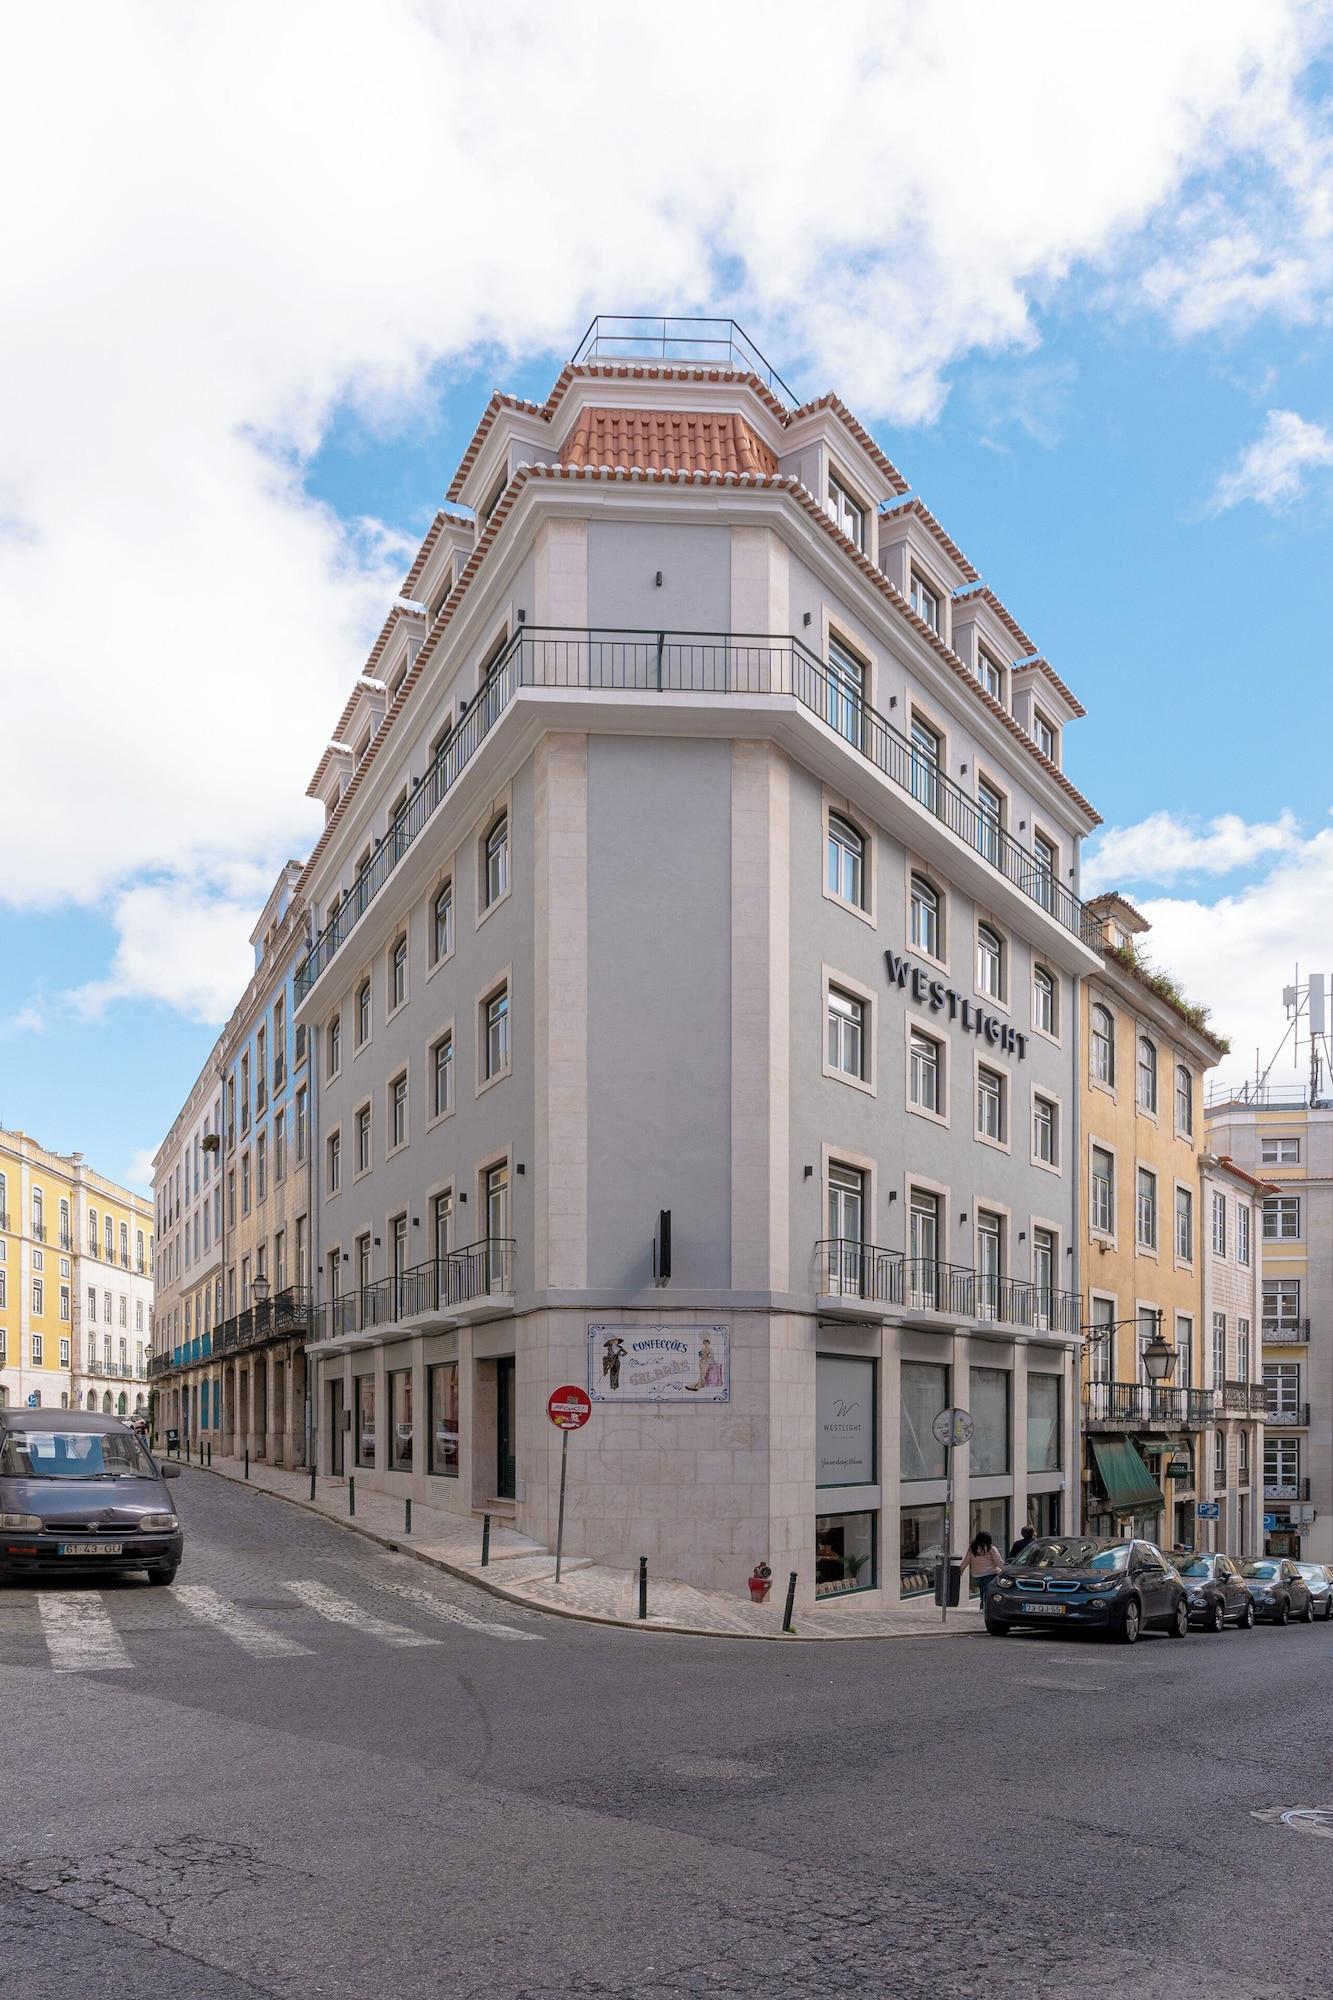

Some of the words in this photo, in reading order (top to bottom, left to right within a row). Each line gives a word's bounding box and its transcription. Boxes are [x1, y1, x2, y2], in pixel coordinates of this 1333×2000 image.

[885, 950, 1029, 1060] WESTLIGHT
[632, 1338, 688, 1354] CONFECÇÕES
[823, 1424, 862, 1432] WESTLIGHT
[1199, 1504, 1208, 1513] P
